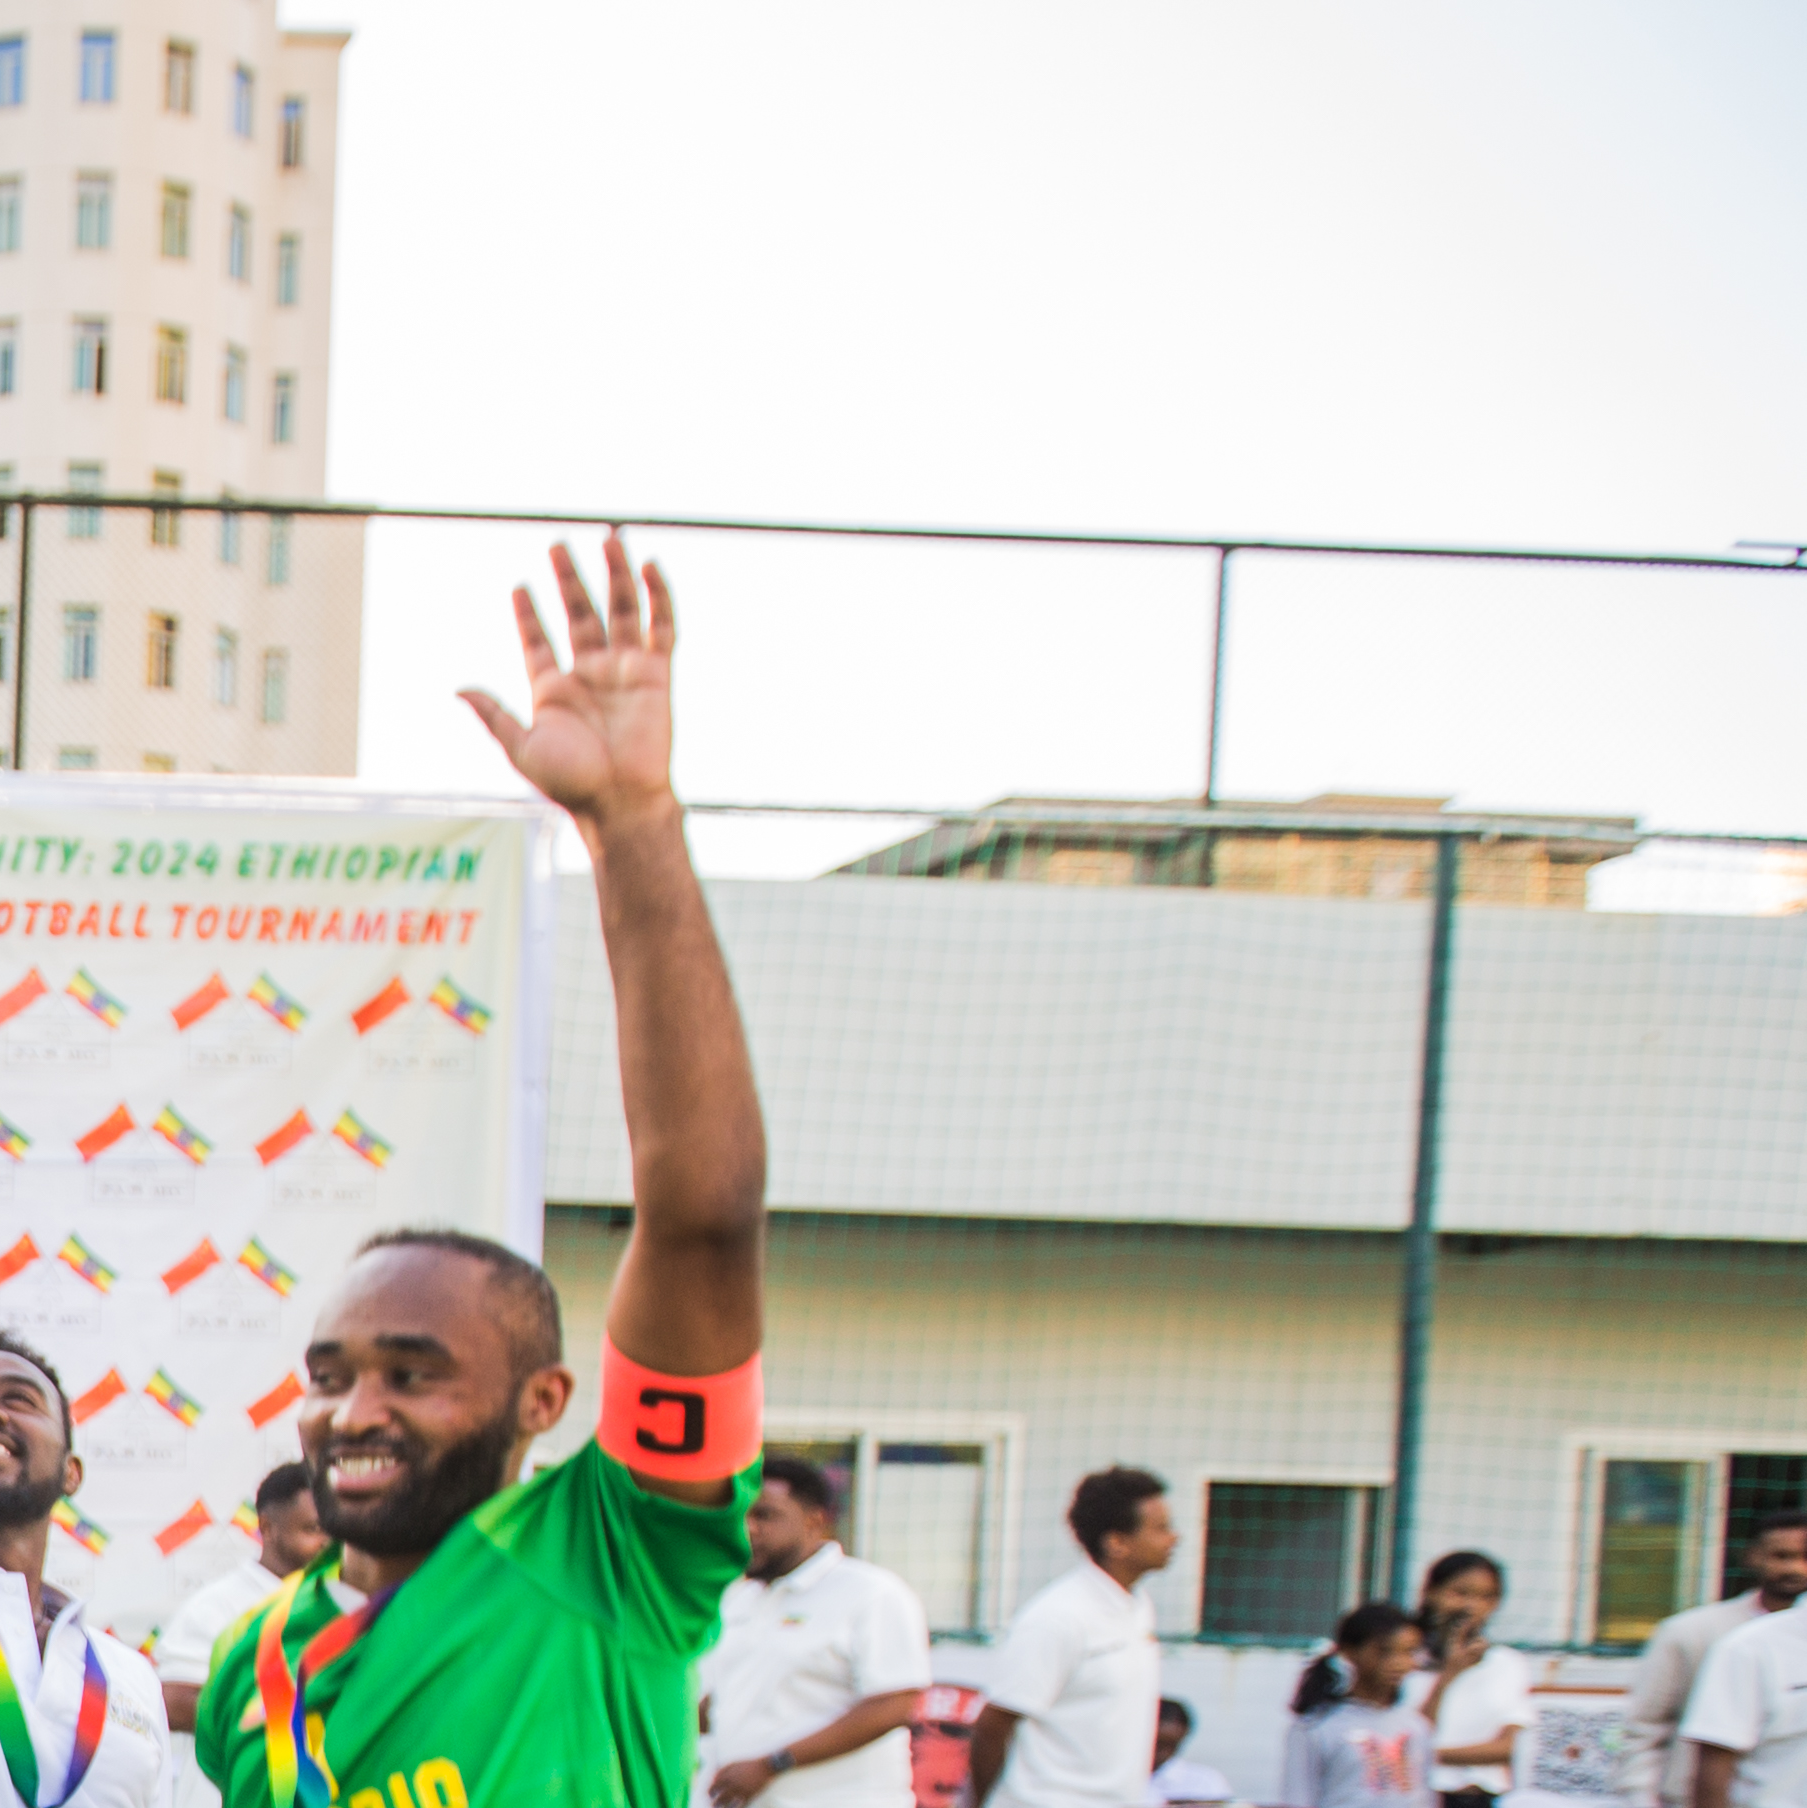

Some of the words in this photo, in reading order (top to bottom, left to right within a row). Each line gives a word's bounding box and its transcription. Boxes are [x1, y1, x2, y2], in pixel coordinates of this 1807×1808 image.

[109, 836, 220, 878] 2024
[236, 841, 480, 884] ETHIOPIAN
[172, 902, 479, 946] TOURNAMENT
[635, 1387, 706, 1457] C
